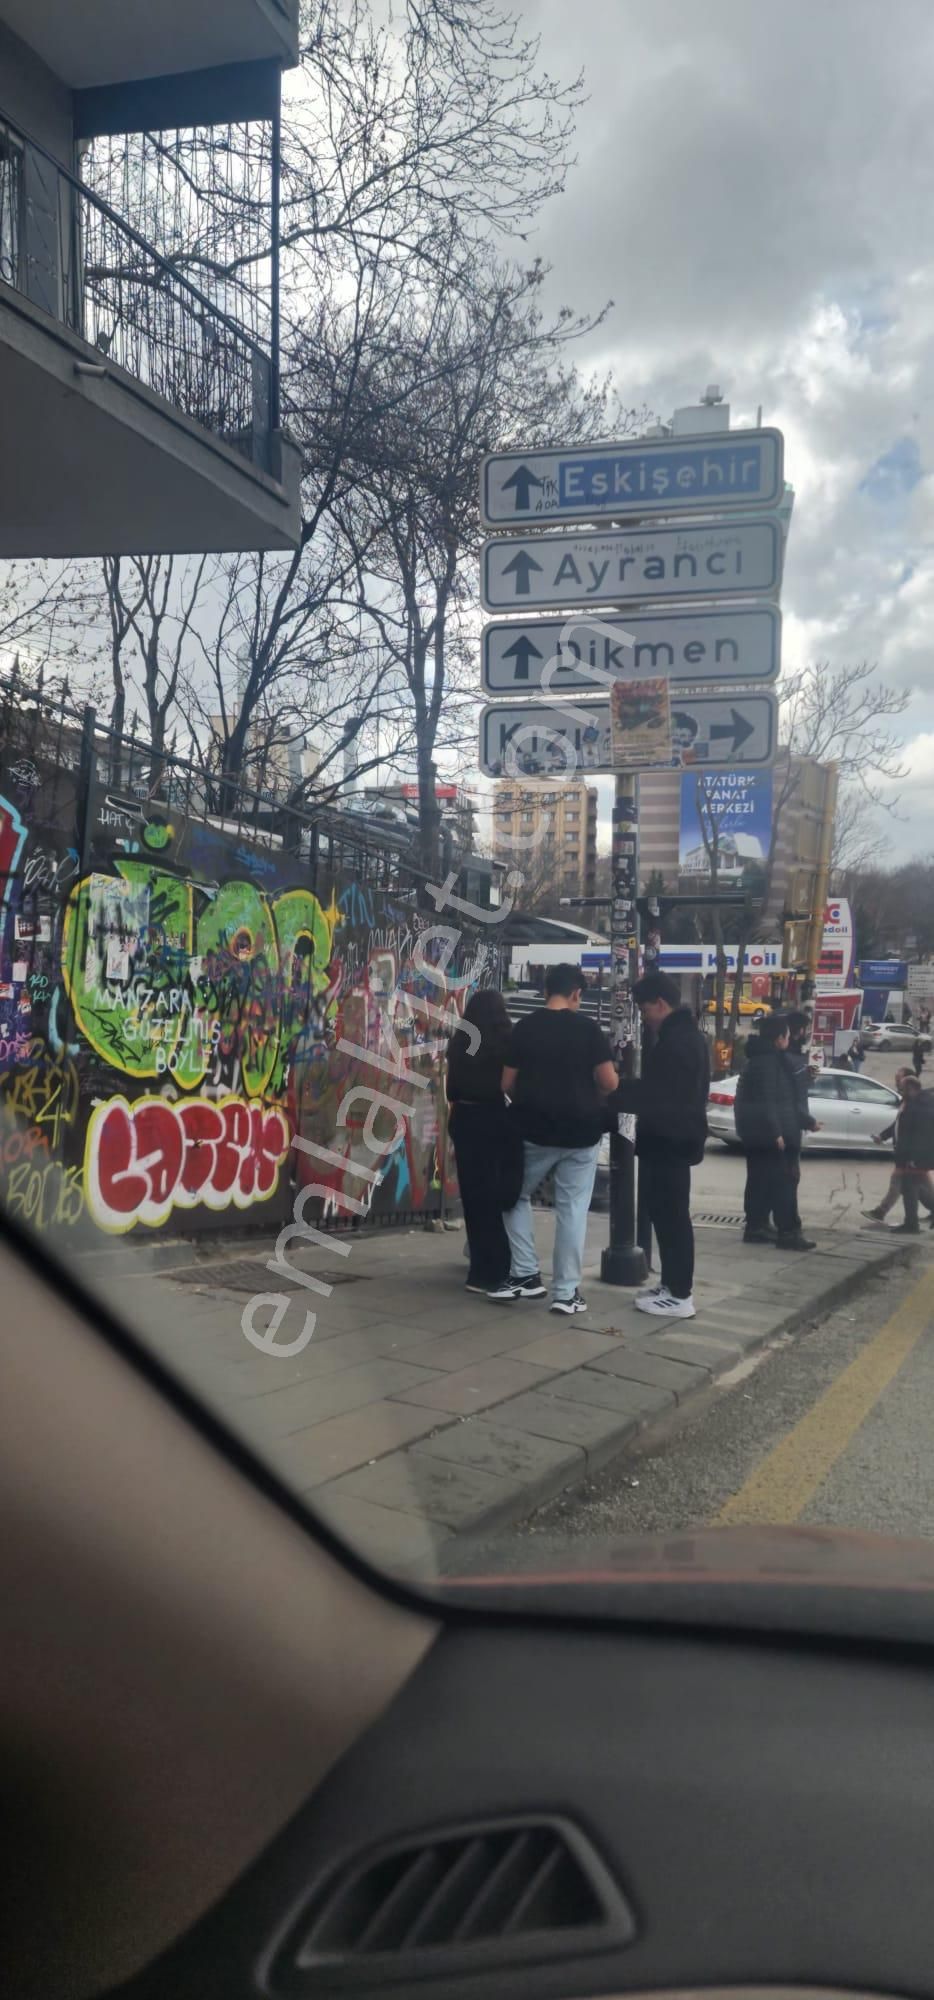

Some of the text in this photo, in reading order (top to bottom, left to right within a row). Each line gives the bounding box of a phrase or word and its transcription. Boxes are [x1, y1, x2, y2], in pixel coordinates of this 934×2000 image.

[563, 458, 757, 497] Eskişehir
[552, 550, 743, 594] Ayrancı
[555, 635, 739, 674] Dikmen
[94, 987, 193, 1014] MANZARA
